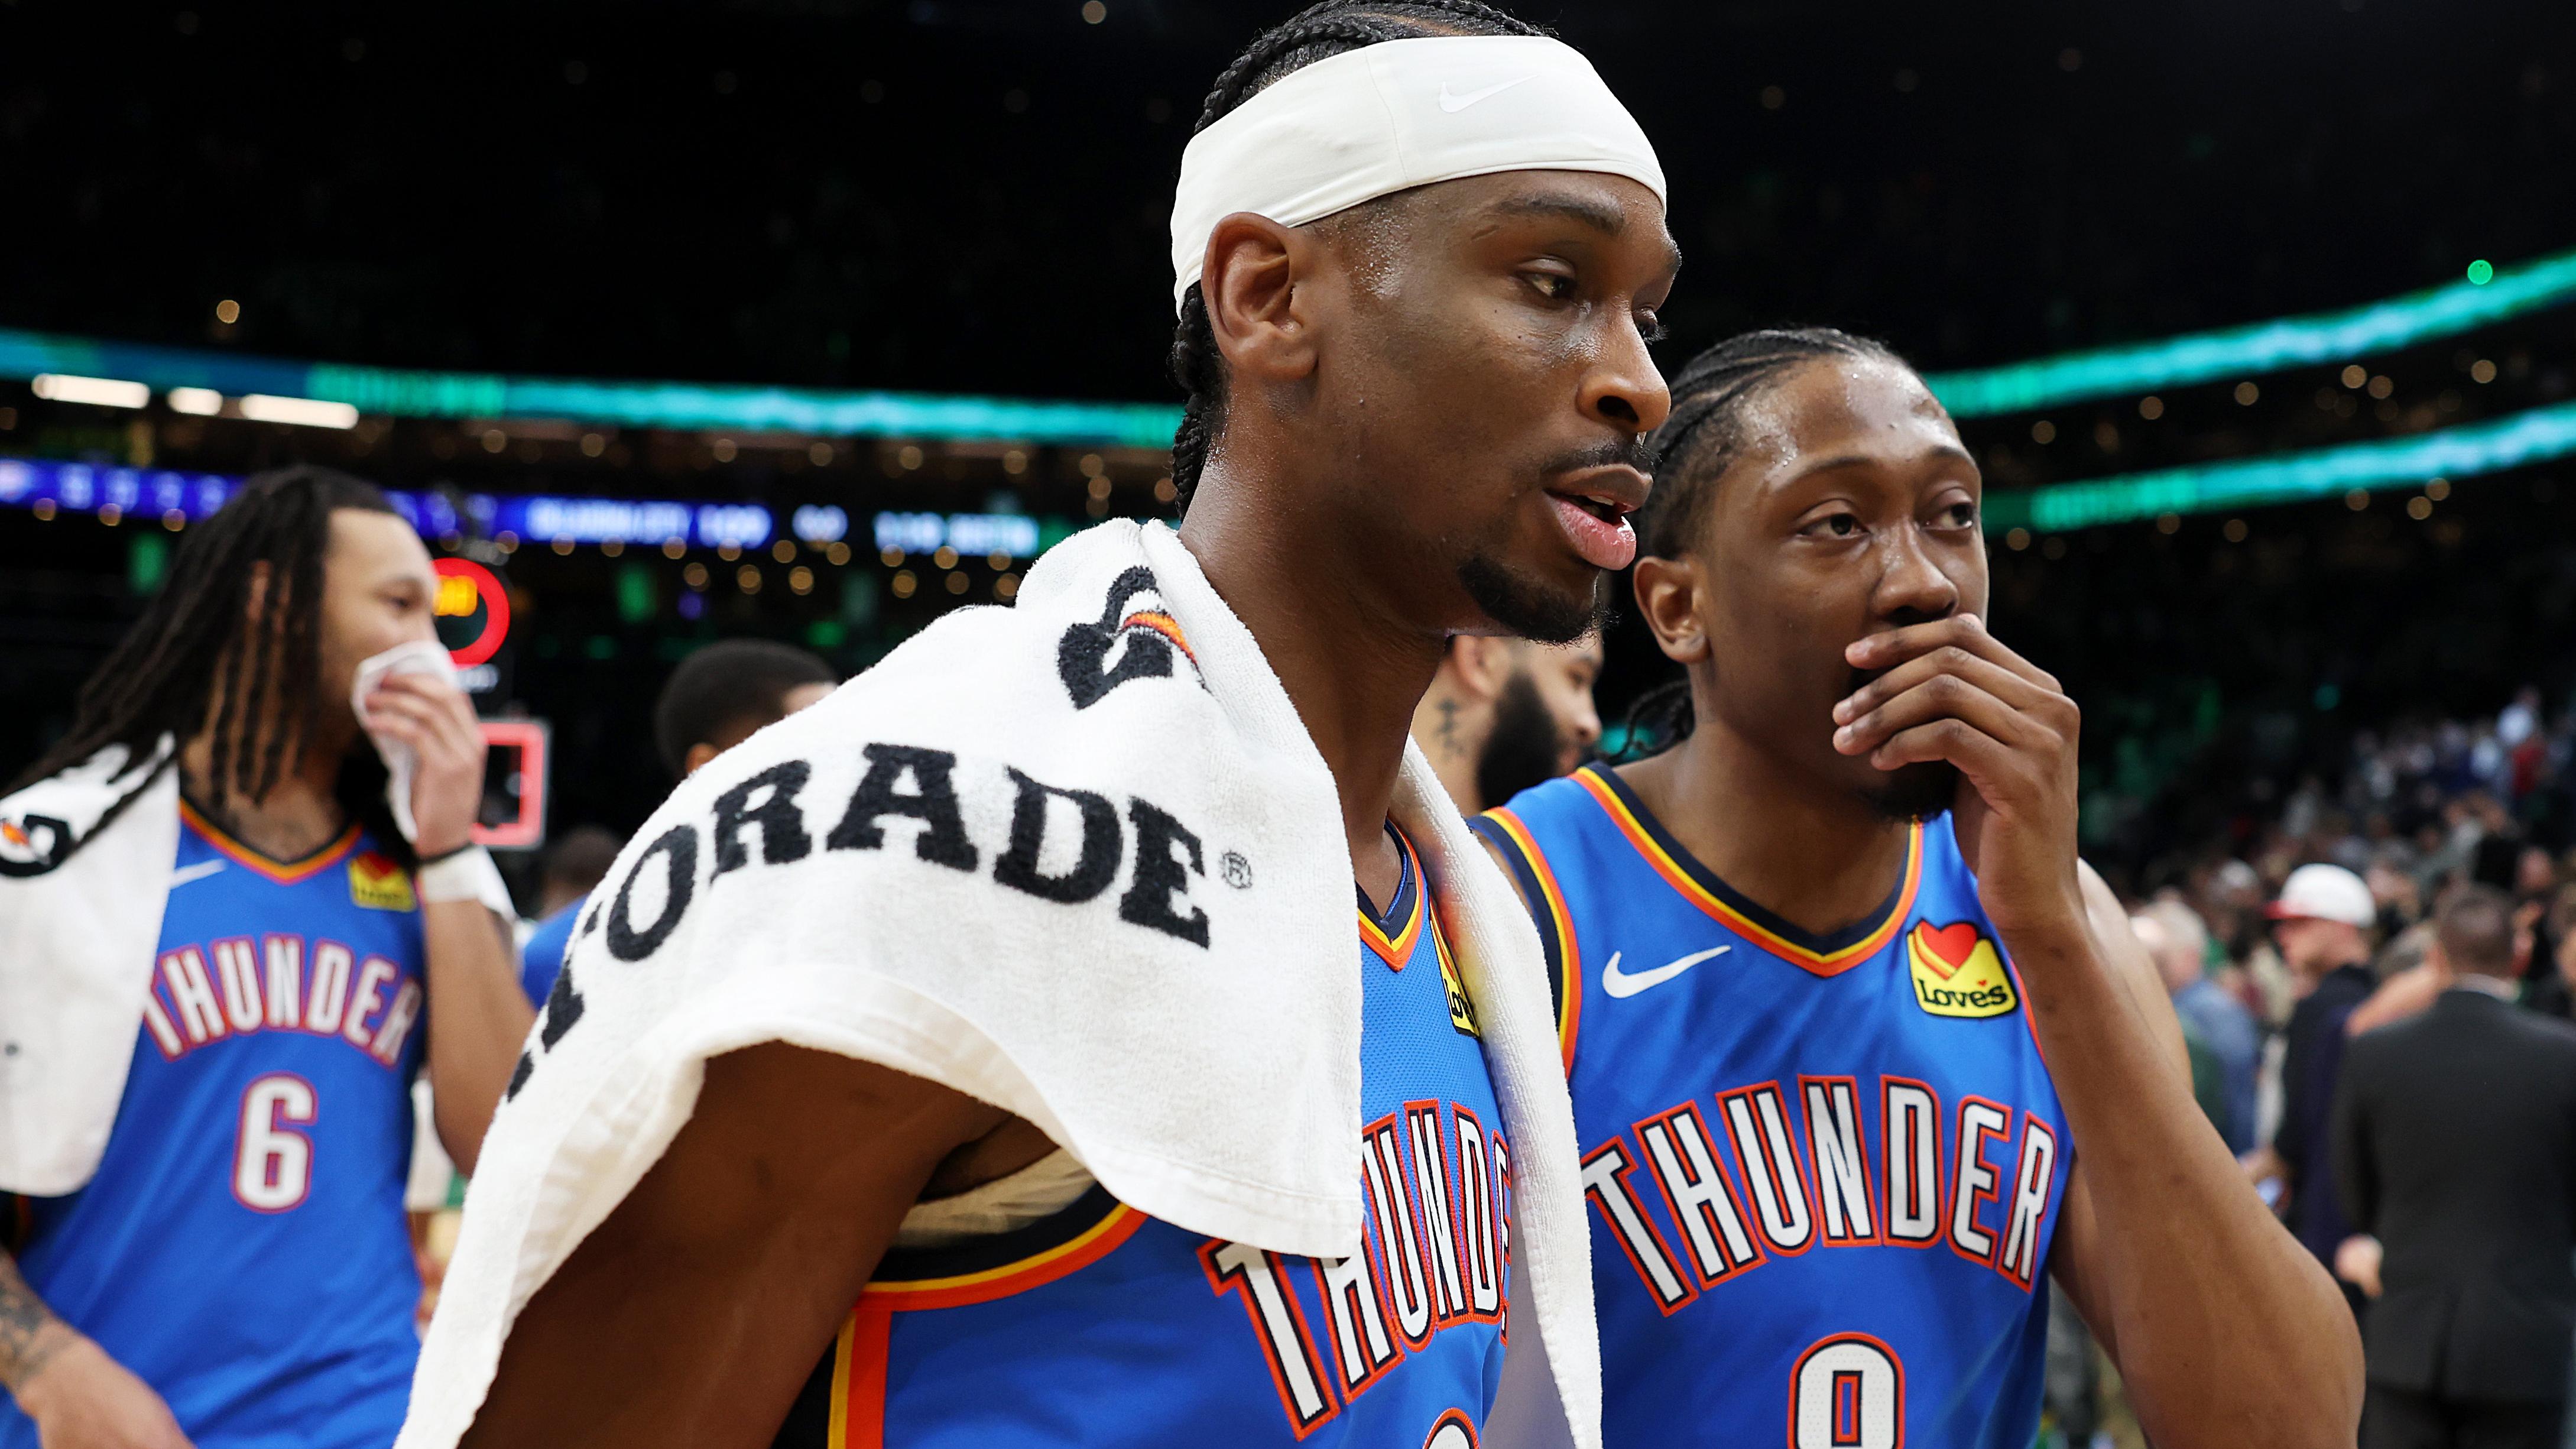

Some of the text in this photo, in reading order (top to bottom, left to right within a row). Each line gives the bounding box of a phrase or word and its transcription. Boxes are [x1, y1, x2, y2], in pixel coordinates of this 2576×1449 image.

[231, 1071, 317, 1213] 6
[1581, 1074, 2057, 1317] THUNDER
[1196, 1098, 1511, 1441] THUNDE
